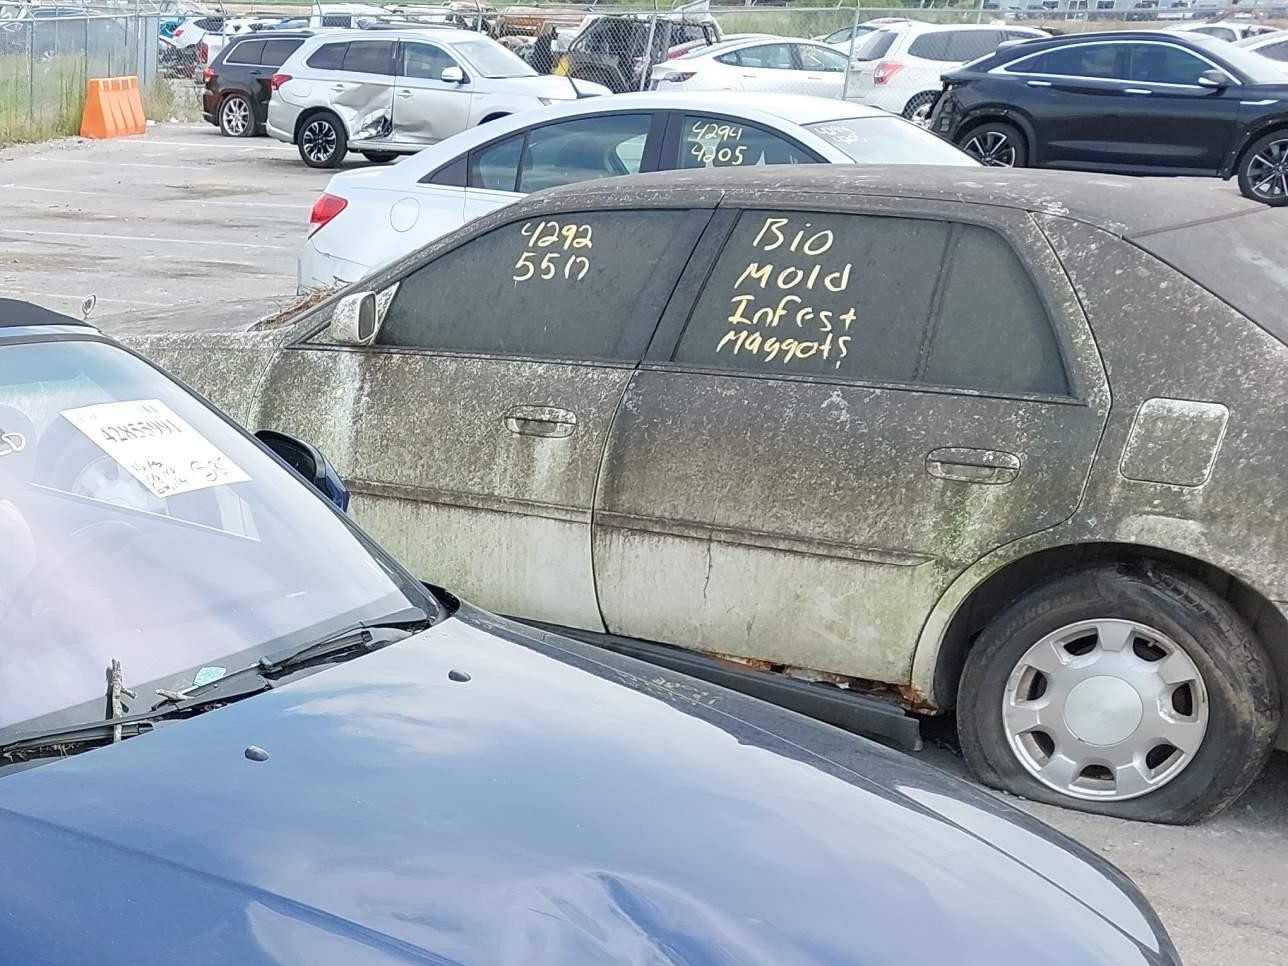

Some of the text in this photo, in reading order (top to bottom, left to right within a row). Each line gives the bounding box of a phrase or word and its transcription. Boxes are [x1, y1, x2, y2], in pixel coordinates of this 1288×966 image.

[692, 121, 743, 141] 4294
[691, 144, 748, 165] 4205
[520, 221, 593, 250] 4292
[512, 252, 590, 281] 5517
